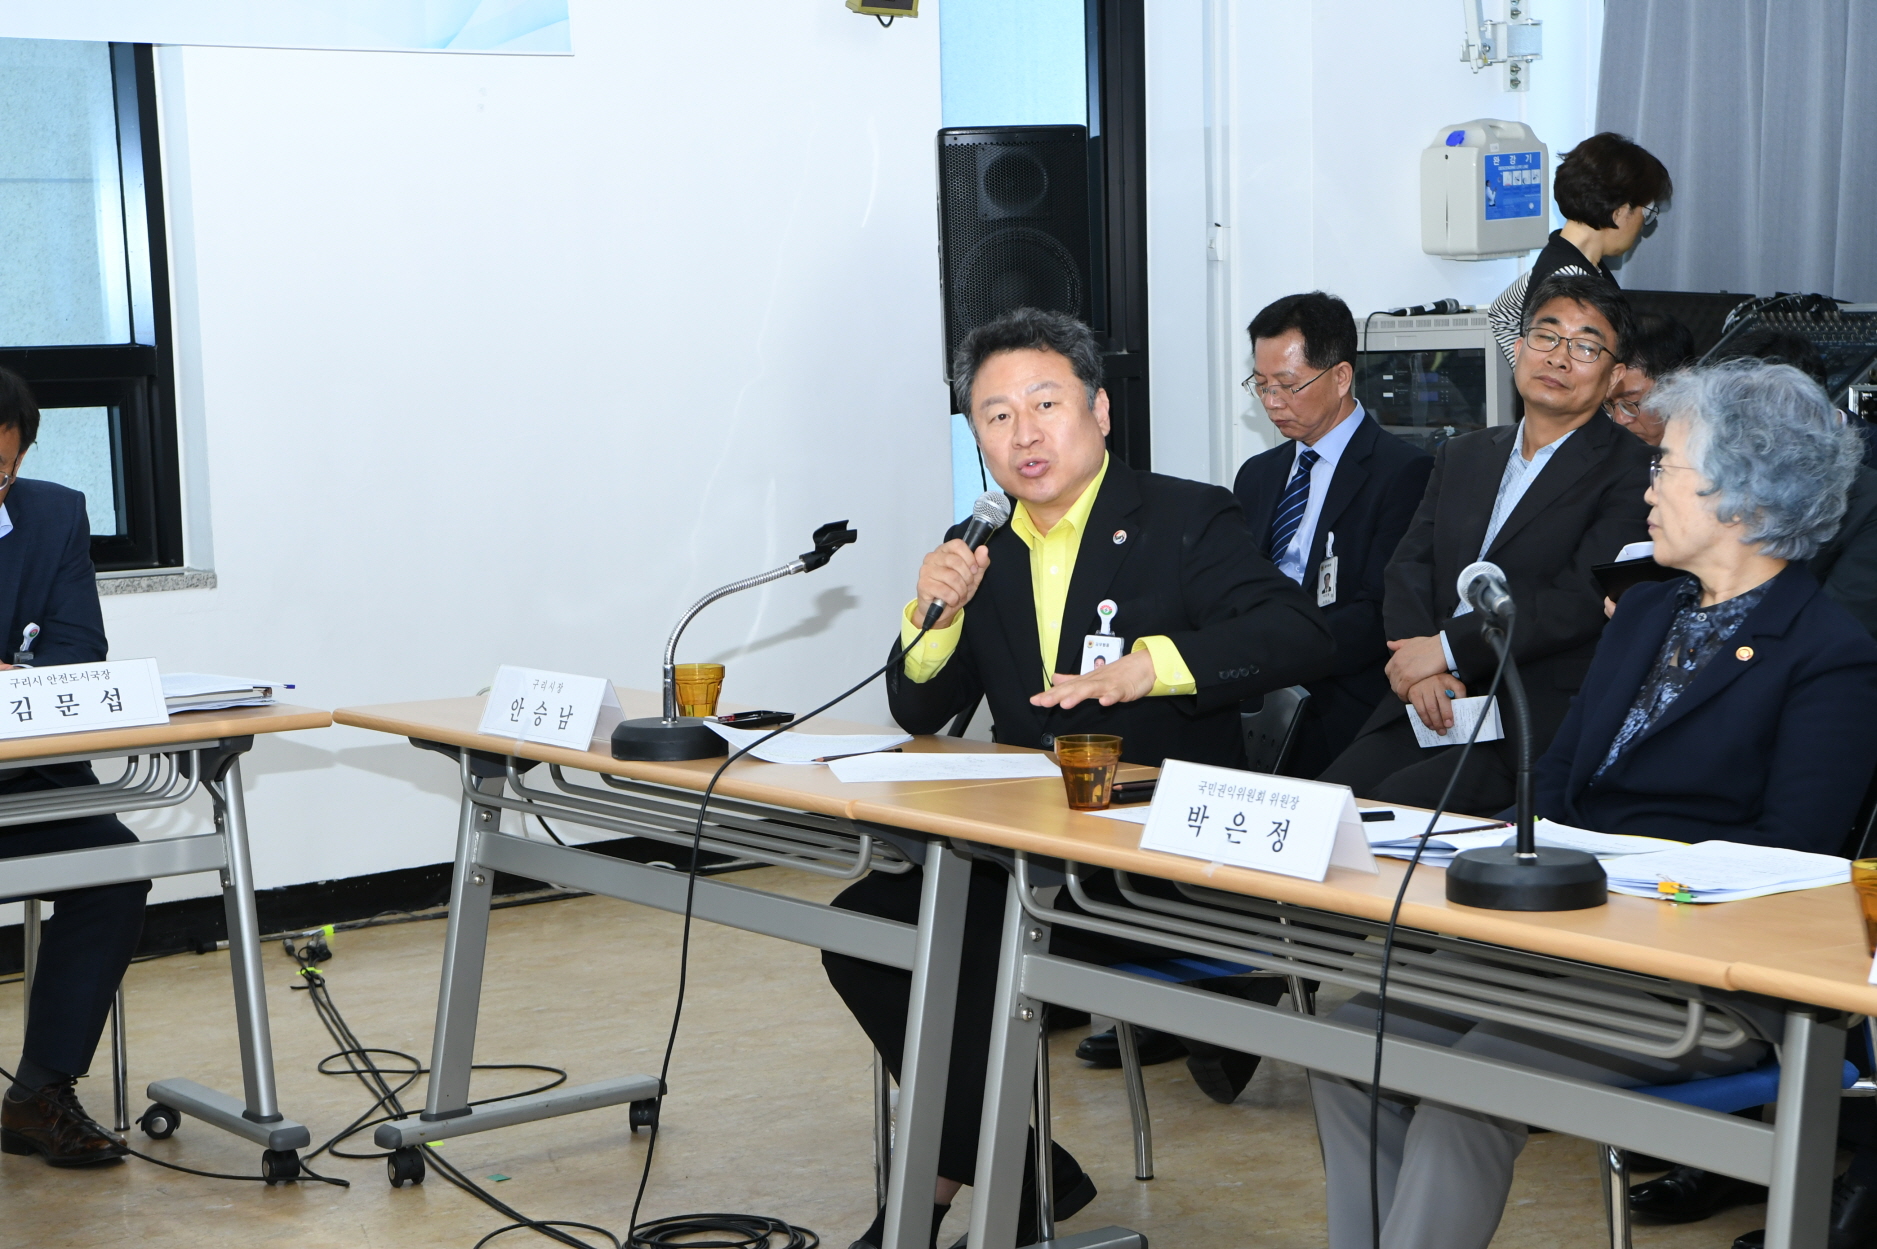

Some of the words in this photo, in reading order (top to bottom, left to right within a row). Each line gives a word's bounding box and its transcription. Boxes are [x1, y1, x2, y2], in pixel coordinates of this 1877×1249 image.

[9, 675, 43, 689] 구리시
[46, 669, 111, 686] 안전도시국장
[532, 679, 564, 694] 구리시장
[1198, 780, 1266, 804] 국민권익위원회
[1269, 791, 1300, 811] 위원장
